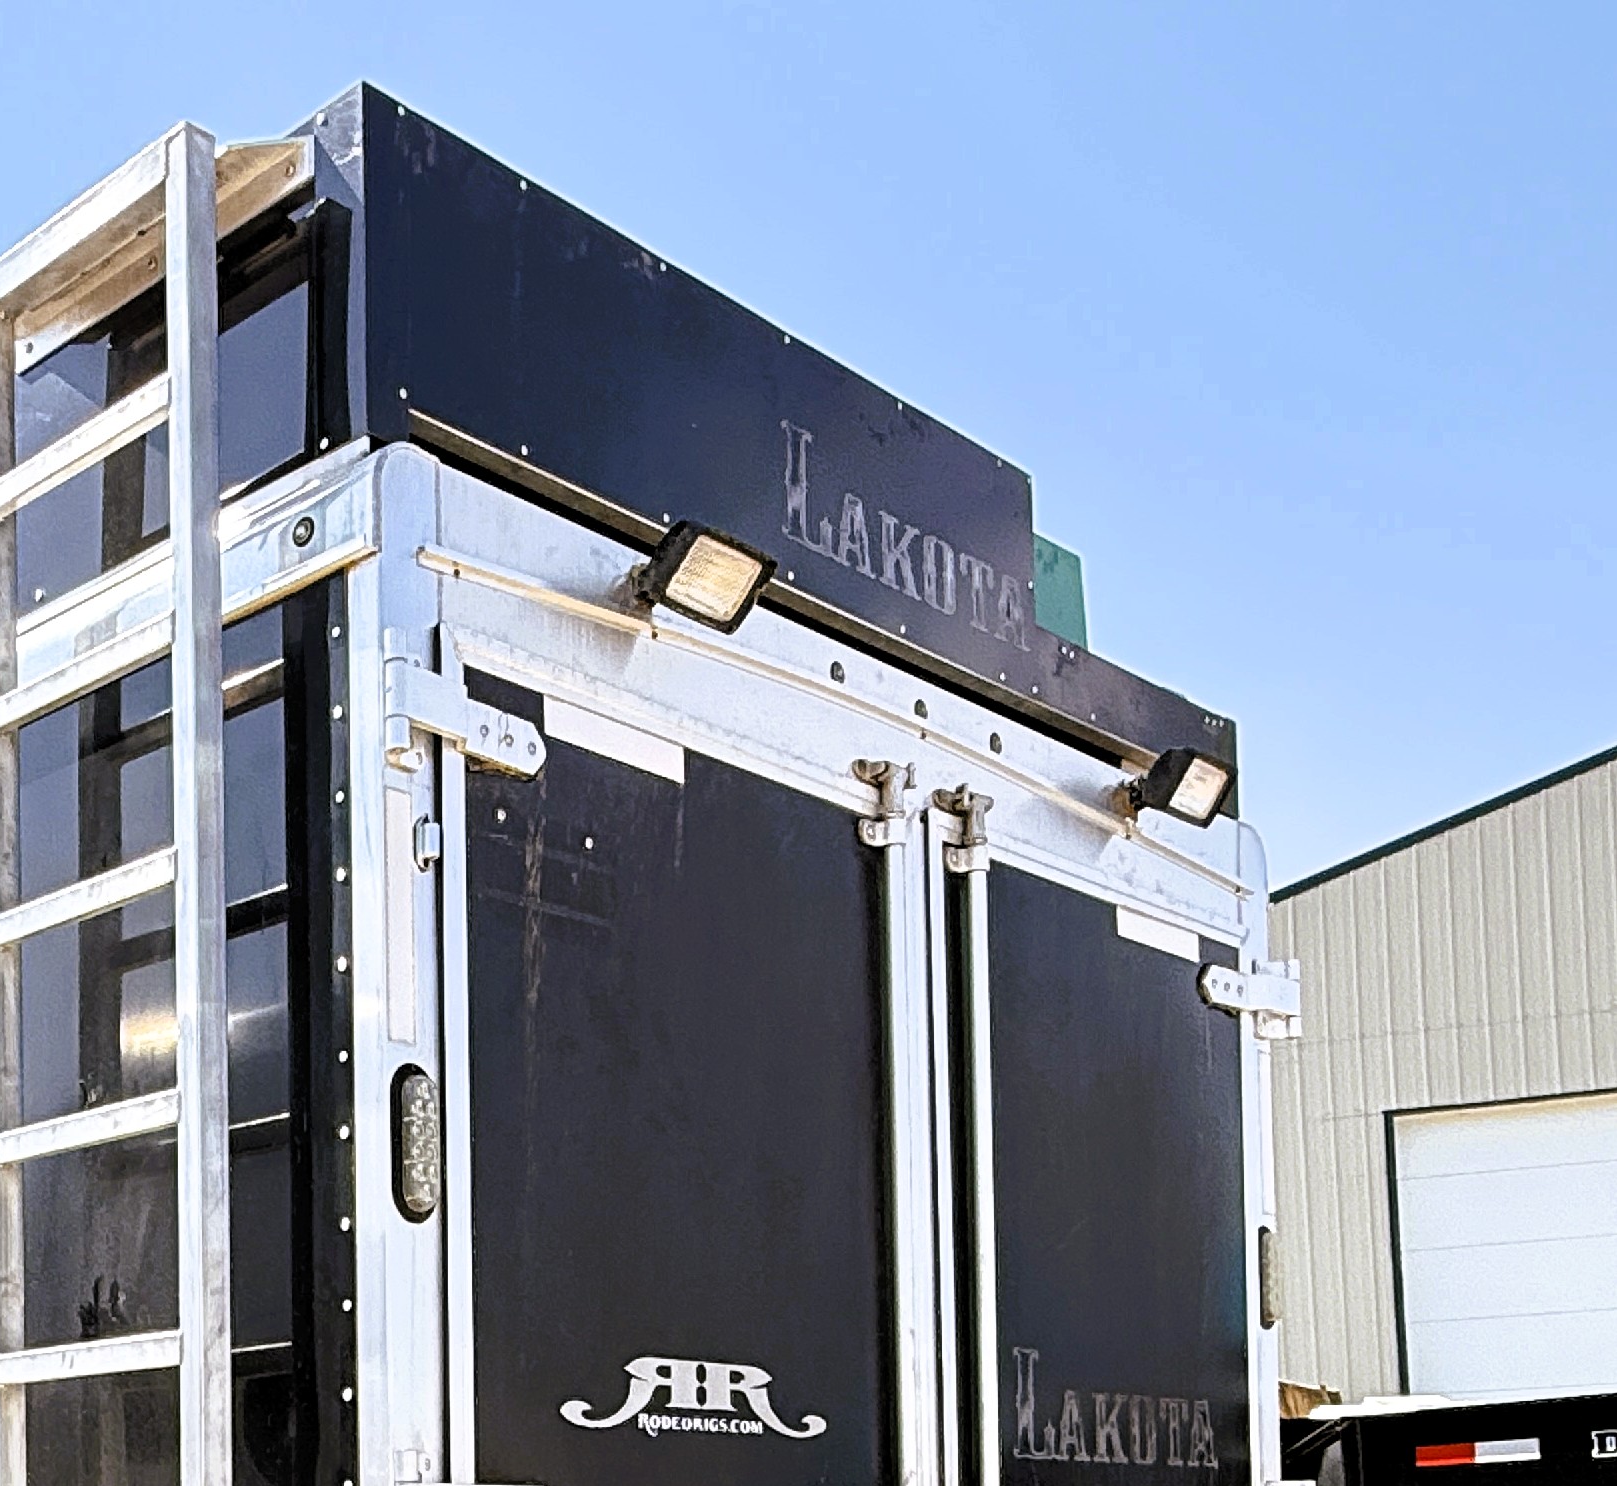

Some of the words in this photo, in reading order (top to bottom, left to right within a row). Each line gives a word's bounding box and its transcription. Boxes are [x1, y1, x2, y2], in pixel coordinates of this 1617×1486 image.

[779, 419, 1031, 653] LAKOTA
[637, 1412, 764, 1438] RODEORIGS.COM
[1013, 1346, 1219, 1470] LAKOTA
